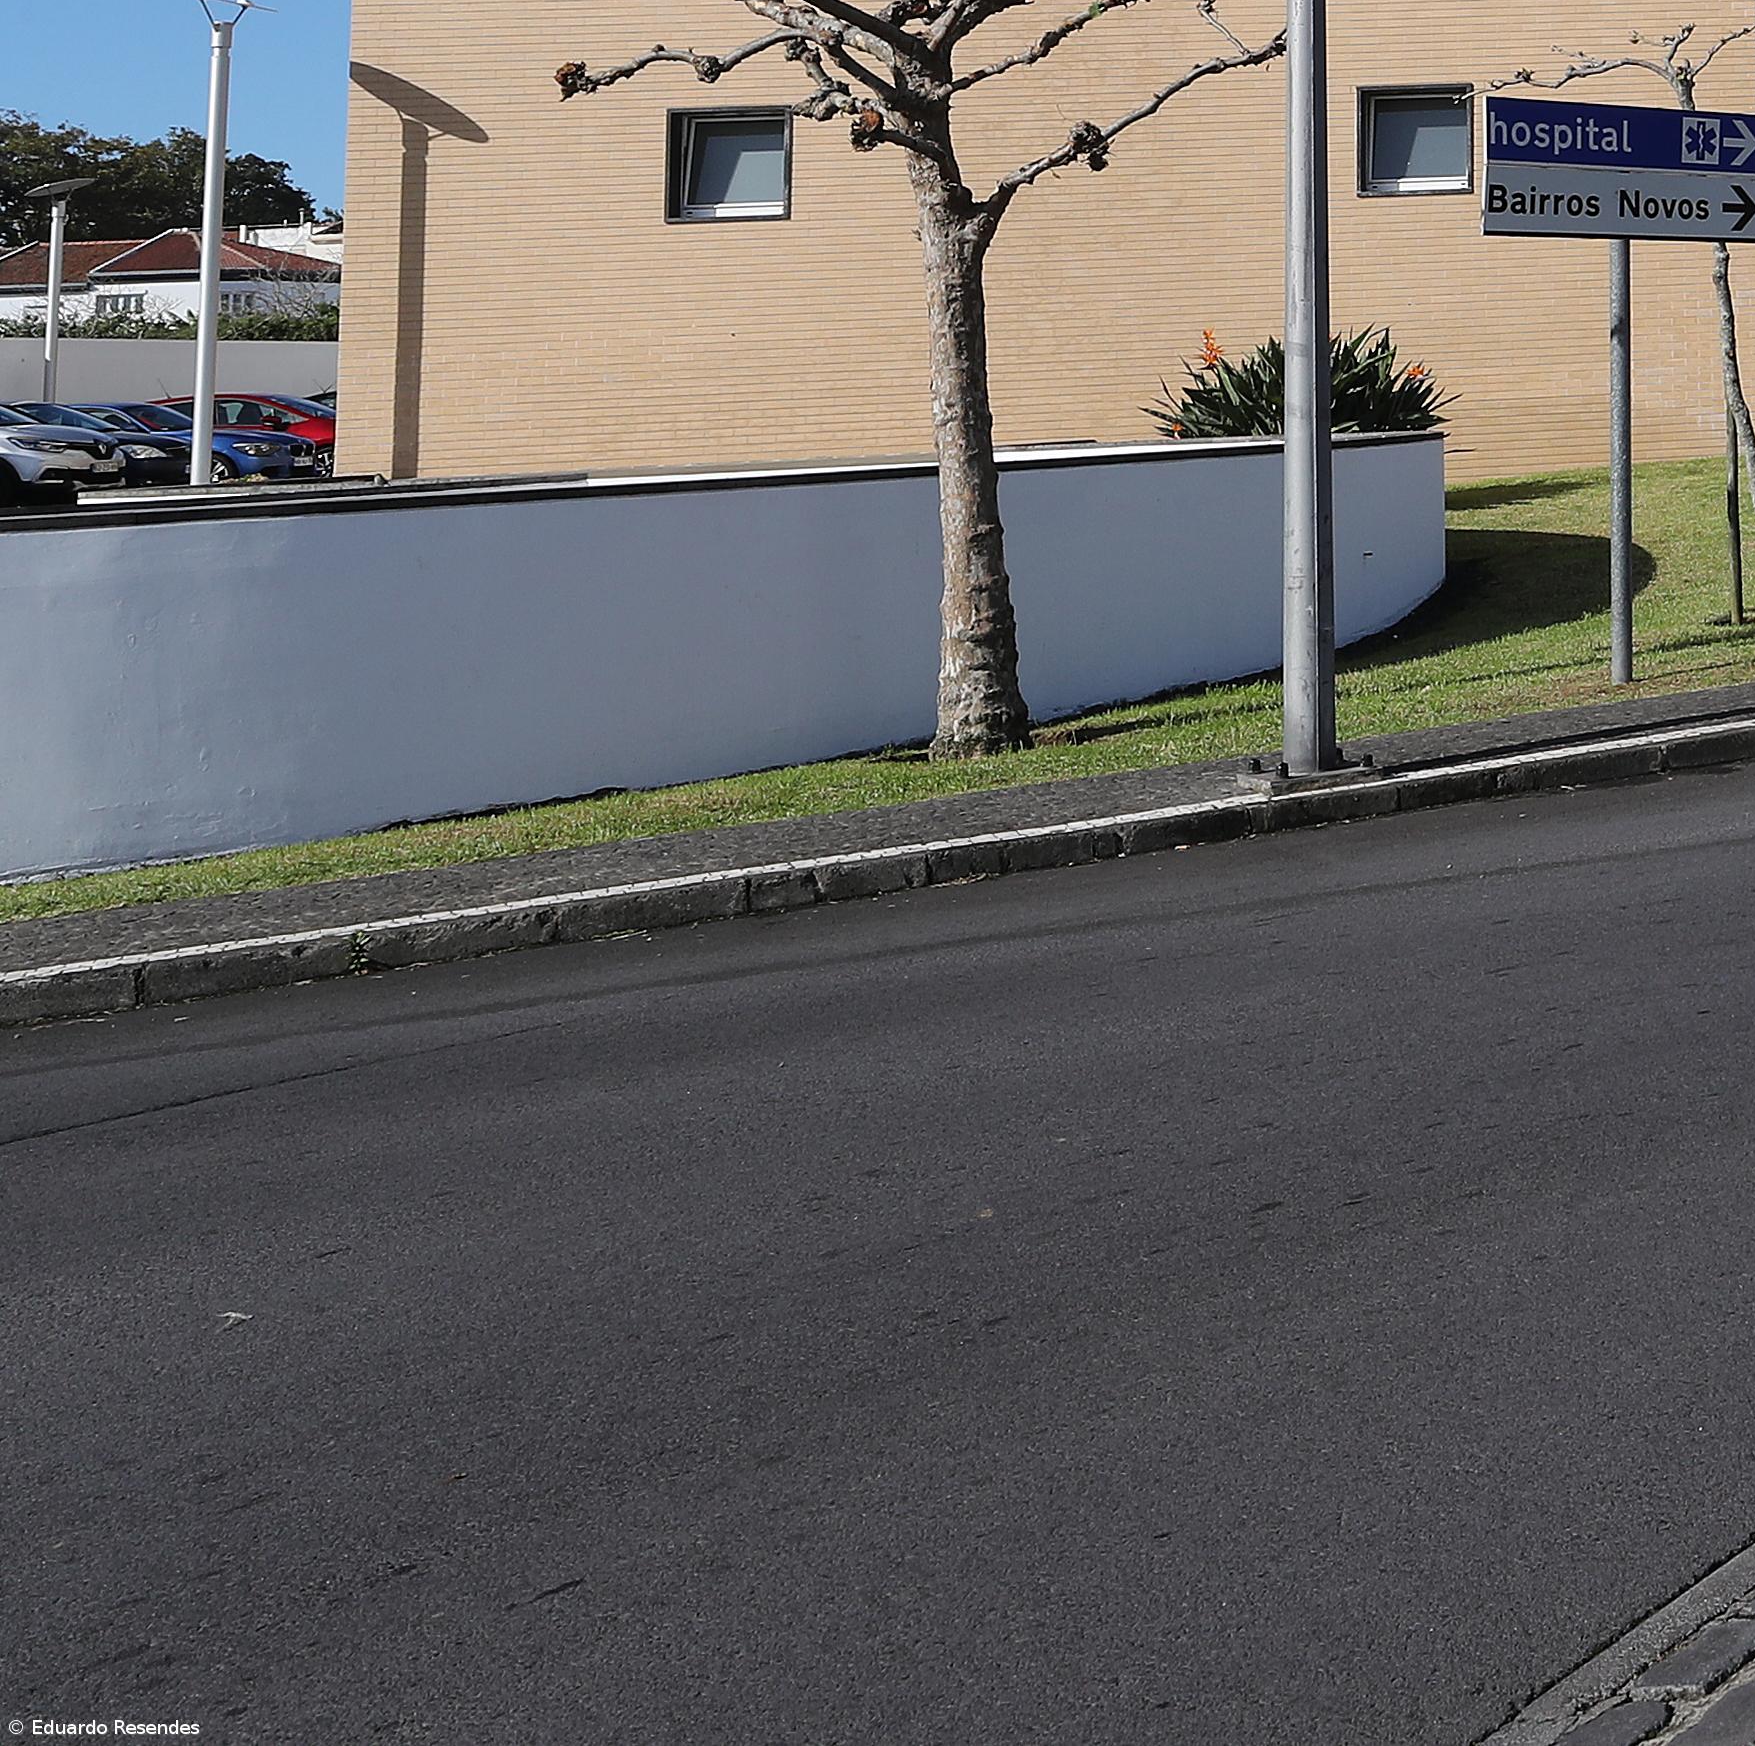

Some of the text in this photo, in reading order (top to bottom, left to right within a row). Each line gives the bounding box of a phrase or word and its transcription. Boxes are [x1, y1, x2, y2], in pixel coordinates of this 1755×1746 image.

[1489, 111, 1632, 155] hospital
[1488, 184, 1710, 221] Bairros Novos
